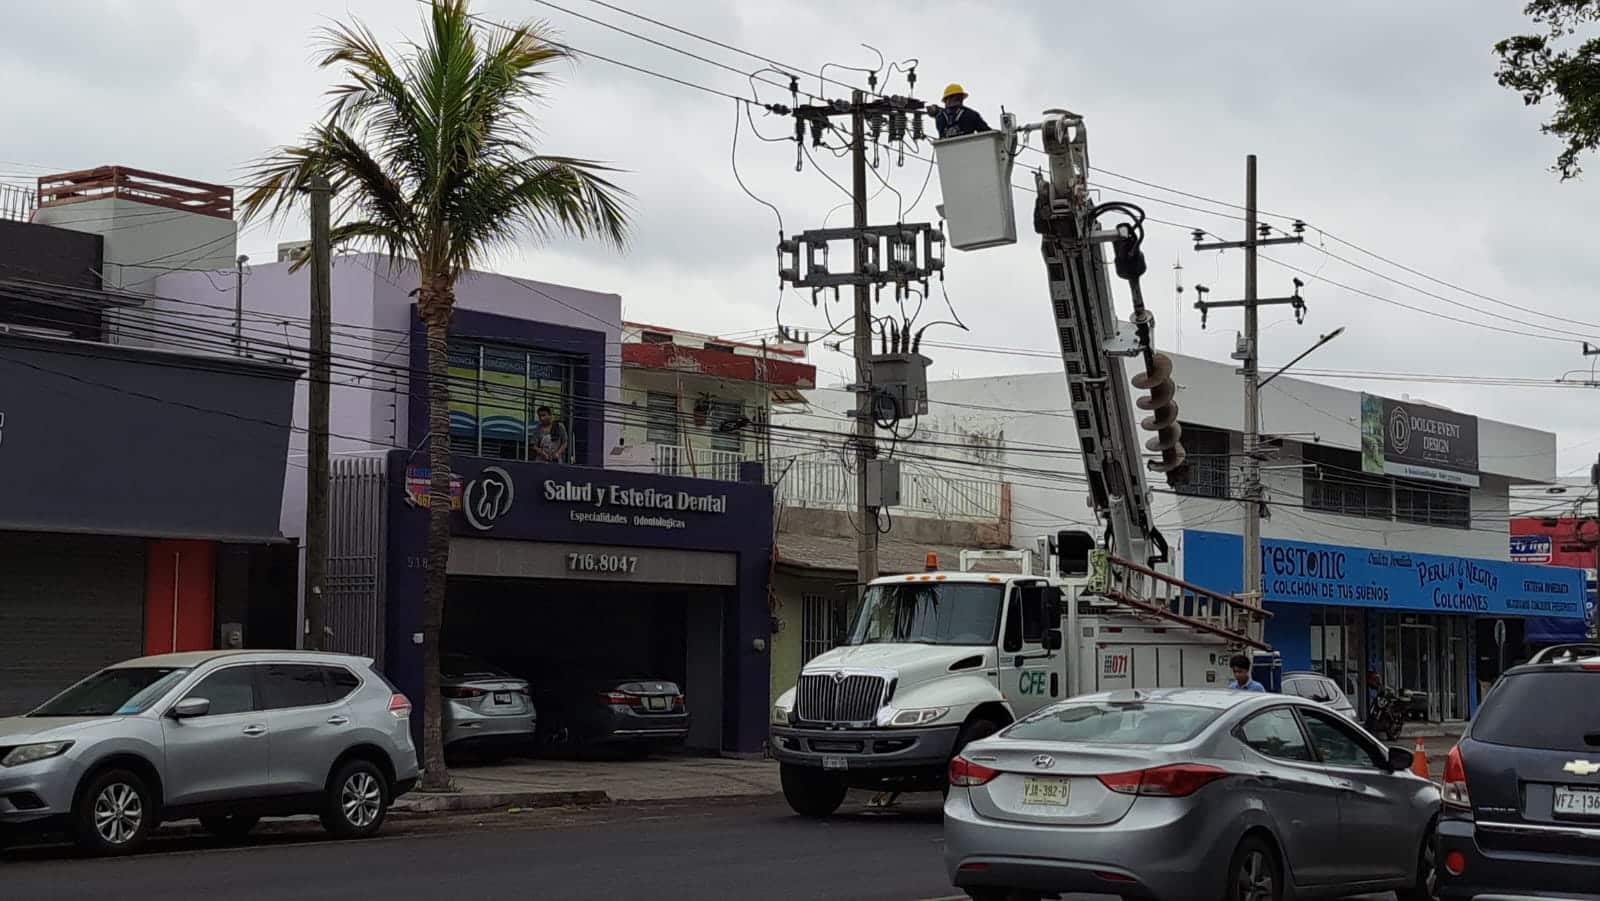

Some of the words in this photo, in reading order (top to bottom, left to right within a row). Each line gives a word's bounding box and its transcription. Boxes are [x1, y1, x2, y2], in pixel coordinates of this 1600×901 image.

[1411, 416, 1436, 433] DOLCE
[1438, 421, 1460, 438] EVENT
[1424, 436, 1449, 453] DESIGN
[544, 480, 591, 501] Salud
[595, 487, 606, 507] y
[677, 491, 727, 513] Dental
[570, 510, 628, 525] Especialidades
[633, 516, 686, 529] Odontologicas
[569, 552, 639, 573] 716.8047
[1322, 583, 1334, 598] DE
[1338, 584, 1353, 599] TUS
[1112, 655, 1128, 674] 071
[1019, 671, 1047, 695] CFE
